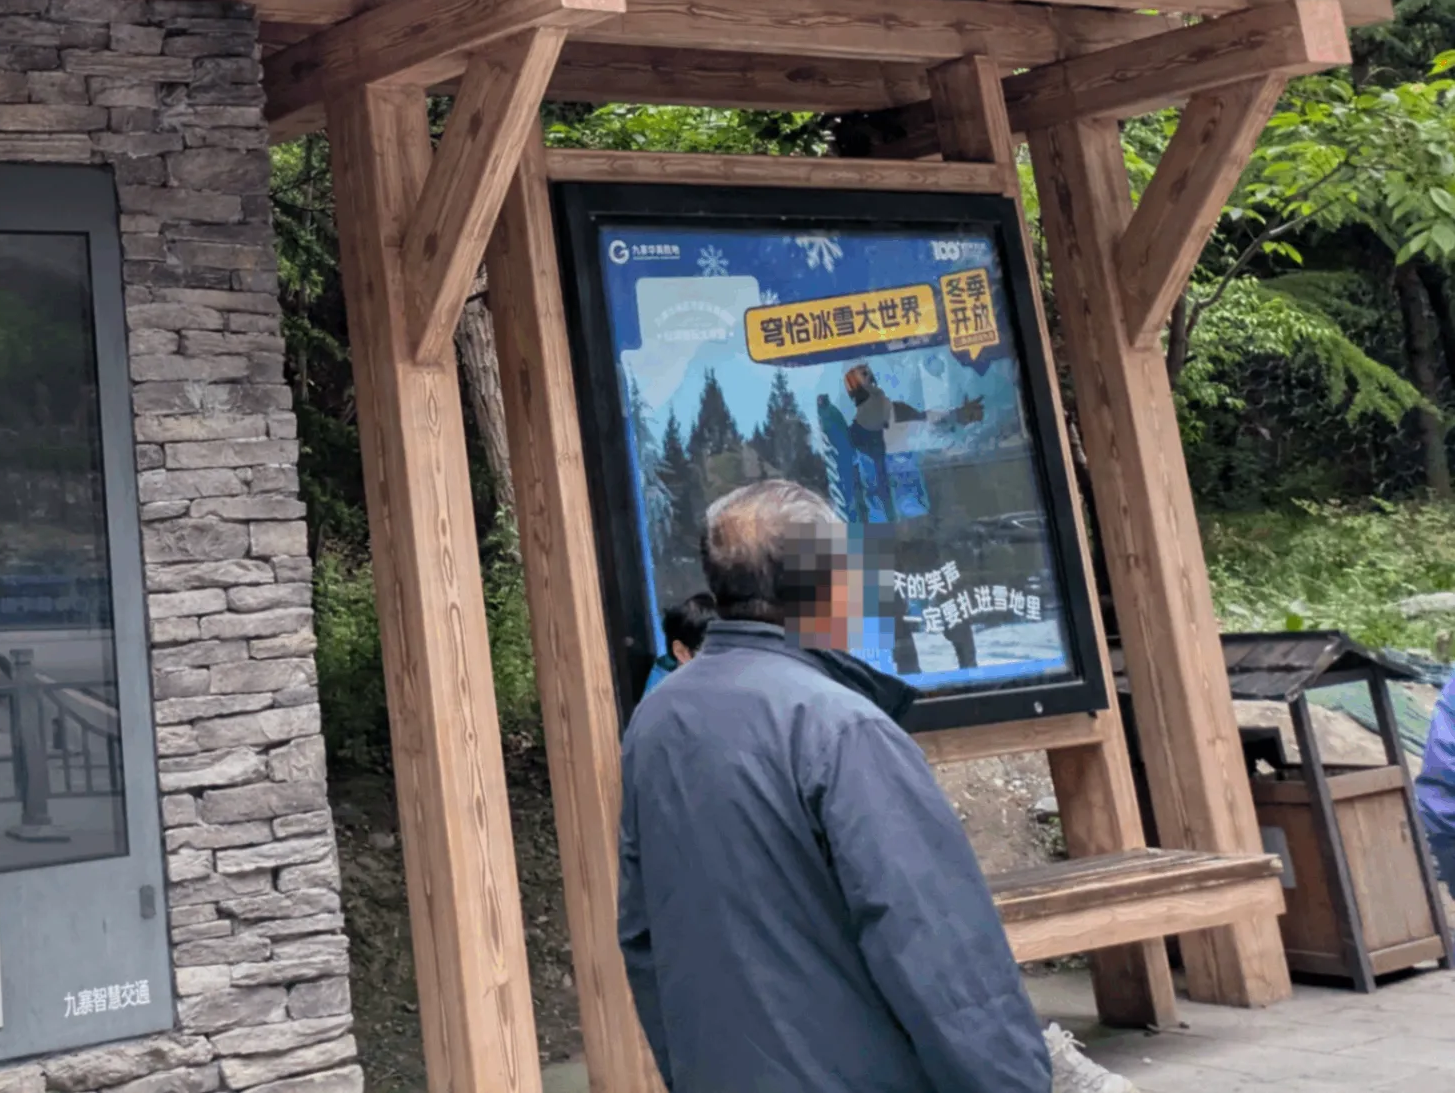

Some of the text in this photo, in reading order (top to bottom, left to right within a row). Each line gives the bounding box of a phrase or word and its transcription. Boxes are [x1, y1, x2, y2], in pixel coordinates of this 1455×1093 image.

[946, 274, 987, 305] 冬季
[760, 295, 922, 348] 穹恰冰雪大世界
[950, 302, 993, 335] 开放
[902, 585, 1042, 634] 一定要扎进雪地里
[64, 979, 152, 1019] 九寨智慧交通
